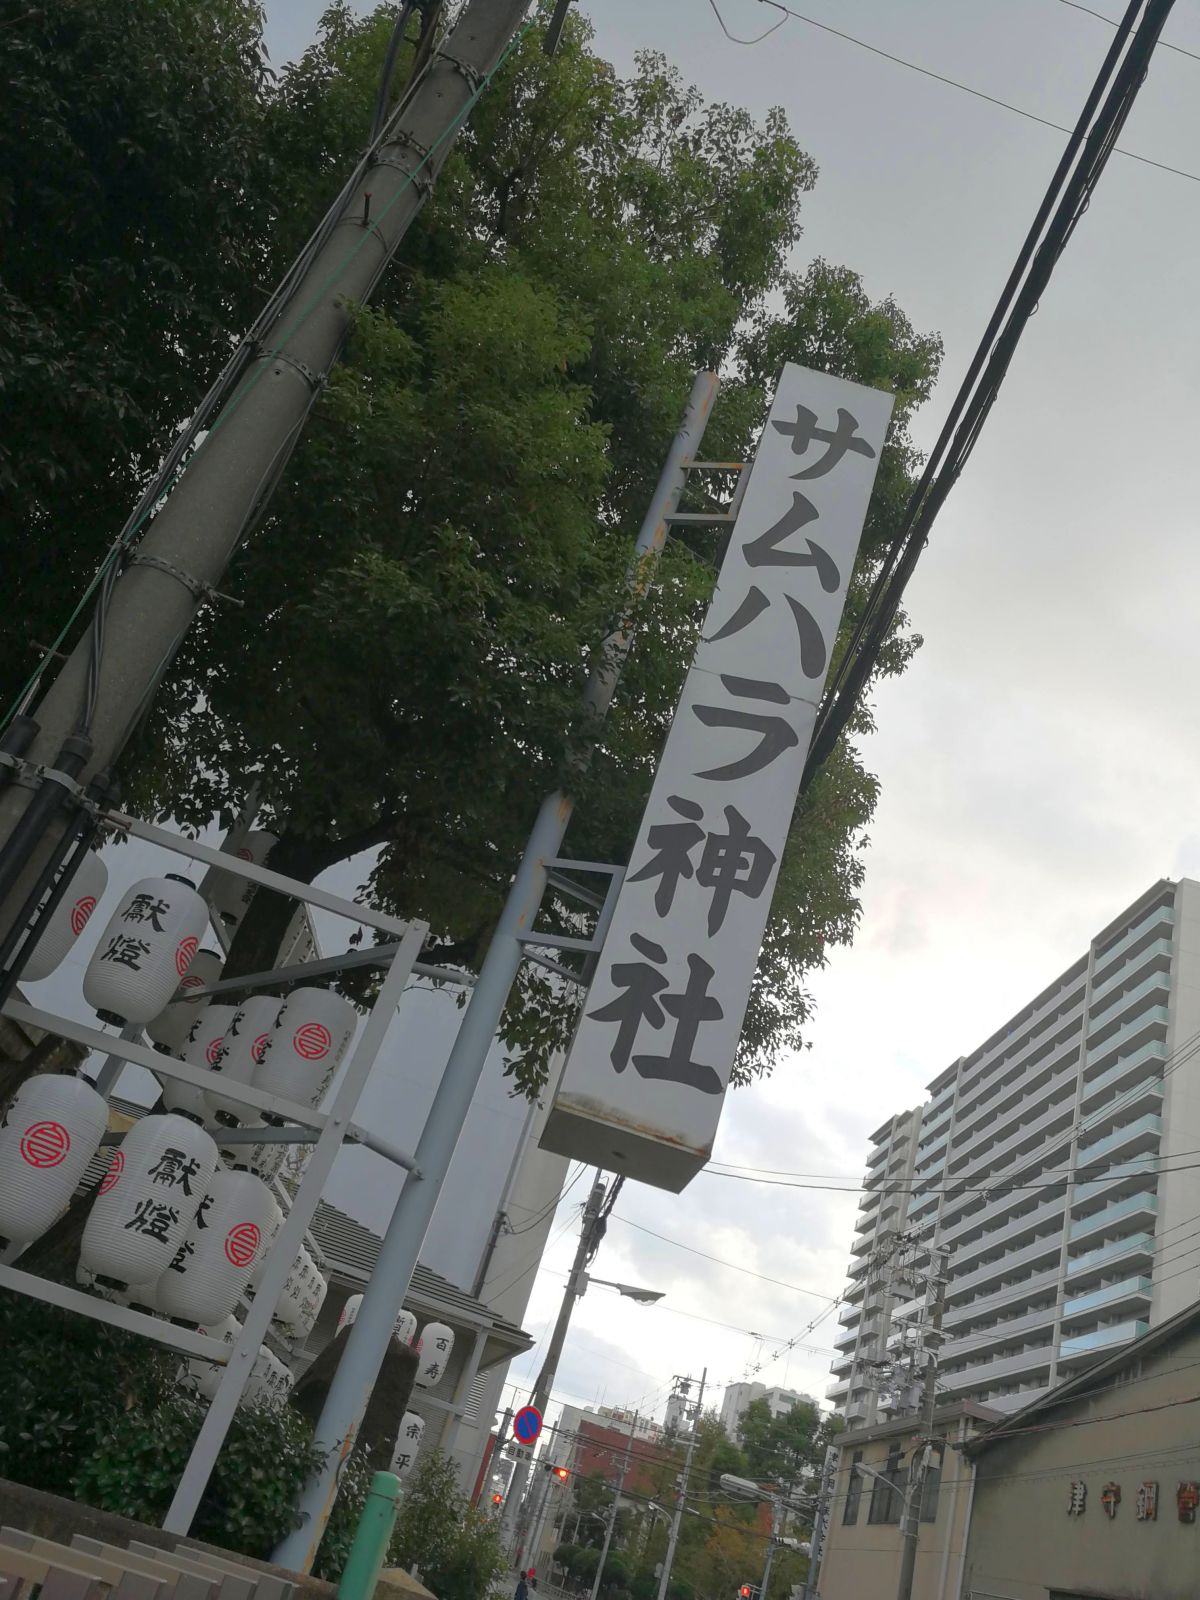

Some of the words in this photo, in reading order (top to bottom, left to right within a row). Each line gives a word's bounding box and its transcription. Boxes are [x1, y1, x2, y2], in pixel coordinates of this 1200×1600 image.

[587, 403, 876, 1096] サムハラ神社
[424, 1337, 449, 1380] 百寿
[395, 1425, 419, 1470] 宗平
